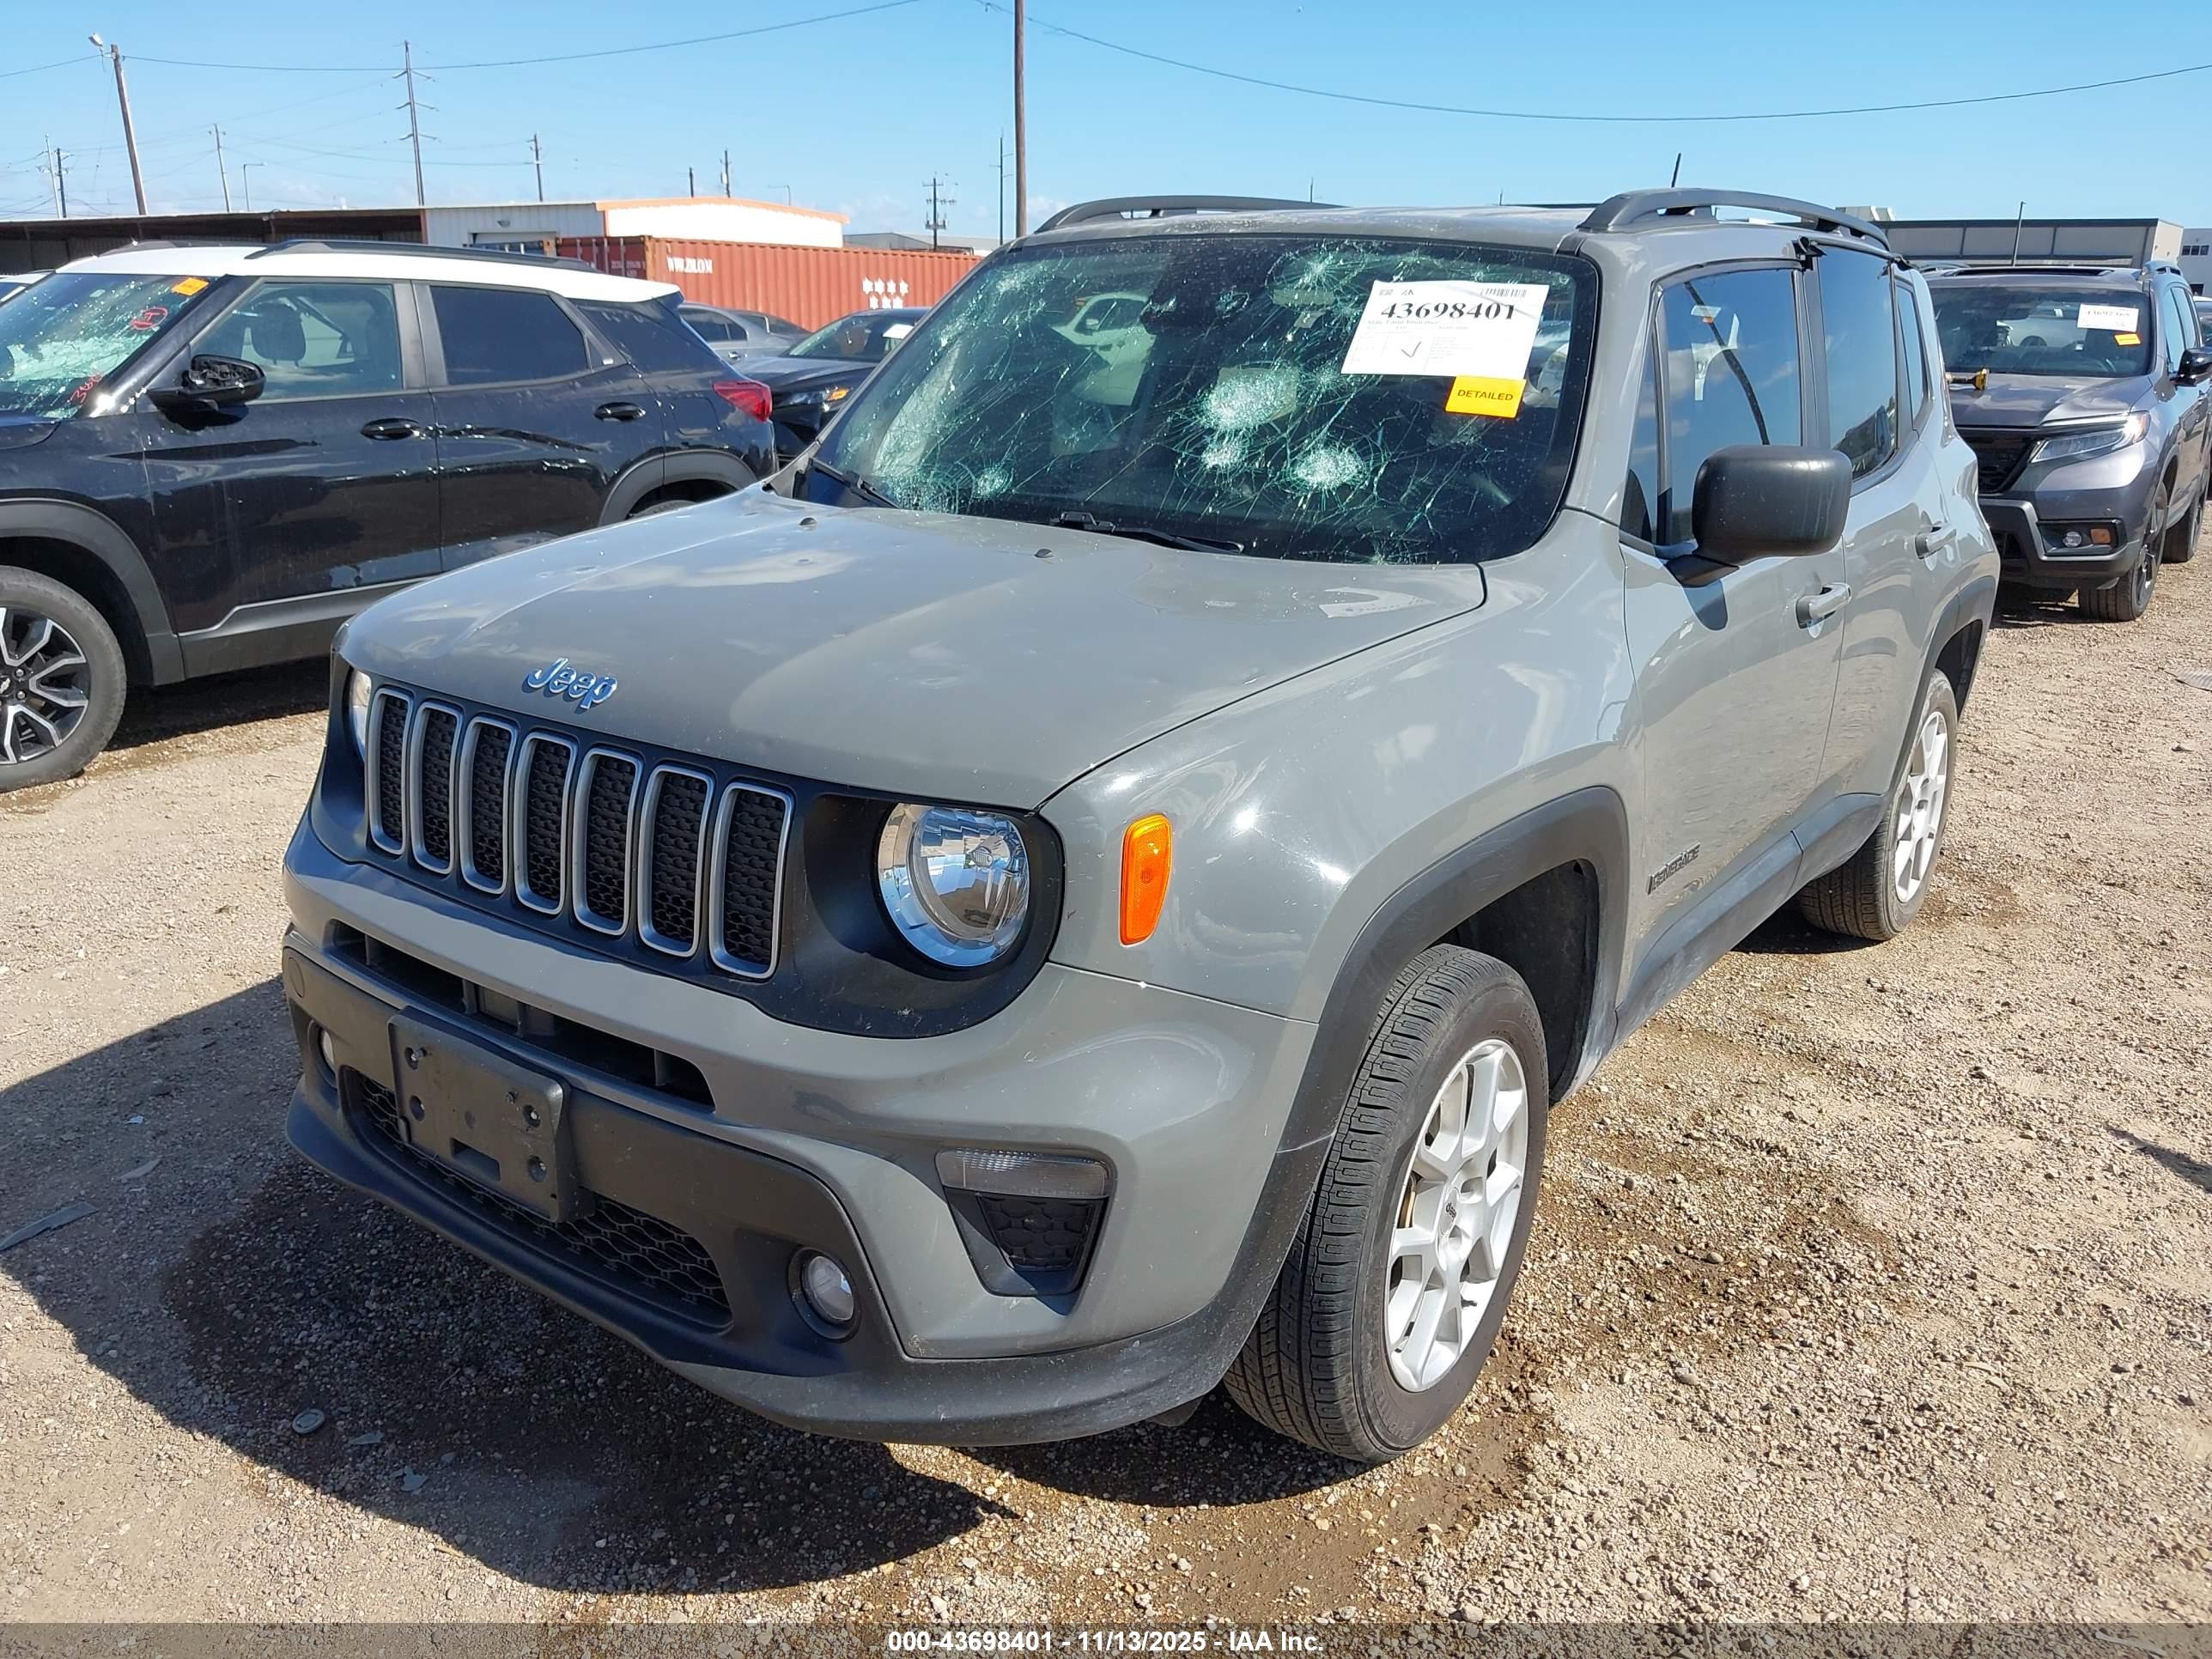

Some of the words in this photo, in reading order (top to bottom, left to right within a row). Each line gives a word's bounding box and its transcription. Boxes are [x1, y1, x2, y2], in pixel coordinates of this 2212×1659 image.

[1381, 303, 1515, 319] 43698401
[1457, 389, 1513, 401] DETAILED
[527, 657, 618, 709] Jeep
[1646, 841, 1701, 895] RENEGADE
